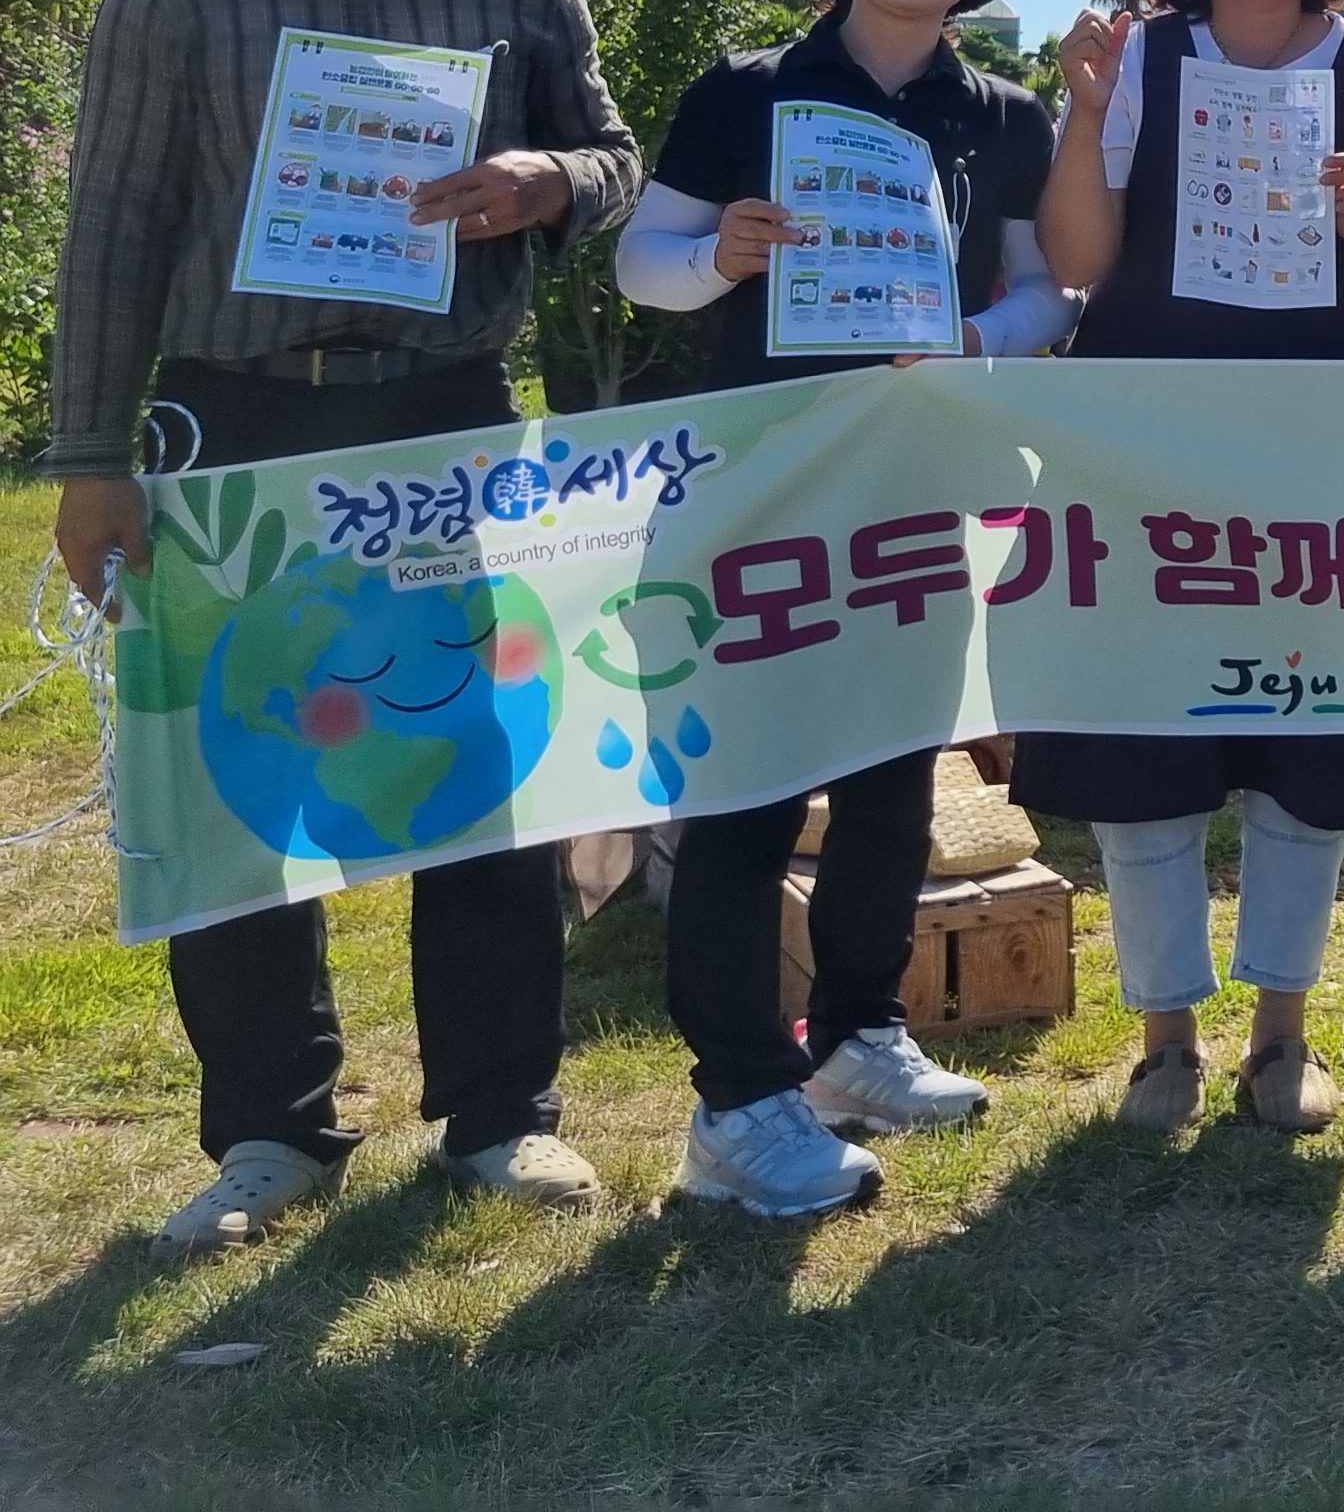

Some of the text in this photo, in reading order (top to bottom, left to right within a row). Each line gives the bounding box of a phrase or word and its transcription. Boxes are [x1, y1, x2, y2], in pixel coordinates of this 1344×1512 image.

[397, 524, 657, 584] Korea, a country of integrity
[710, 503, 1110, 665] 모두가
[1211, 652, 1337, 716] Jeju
